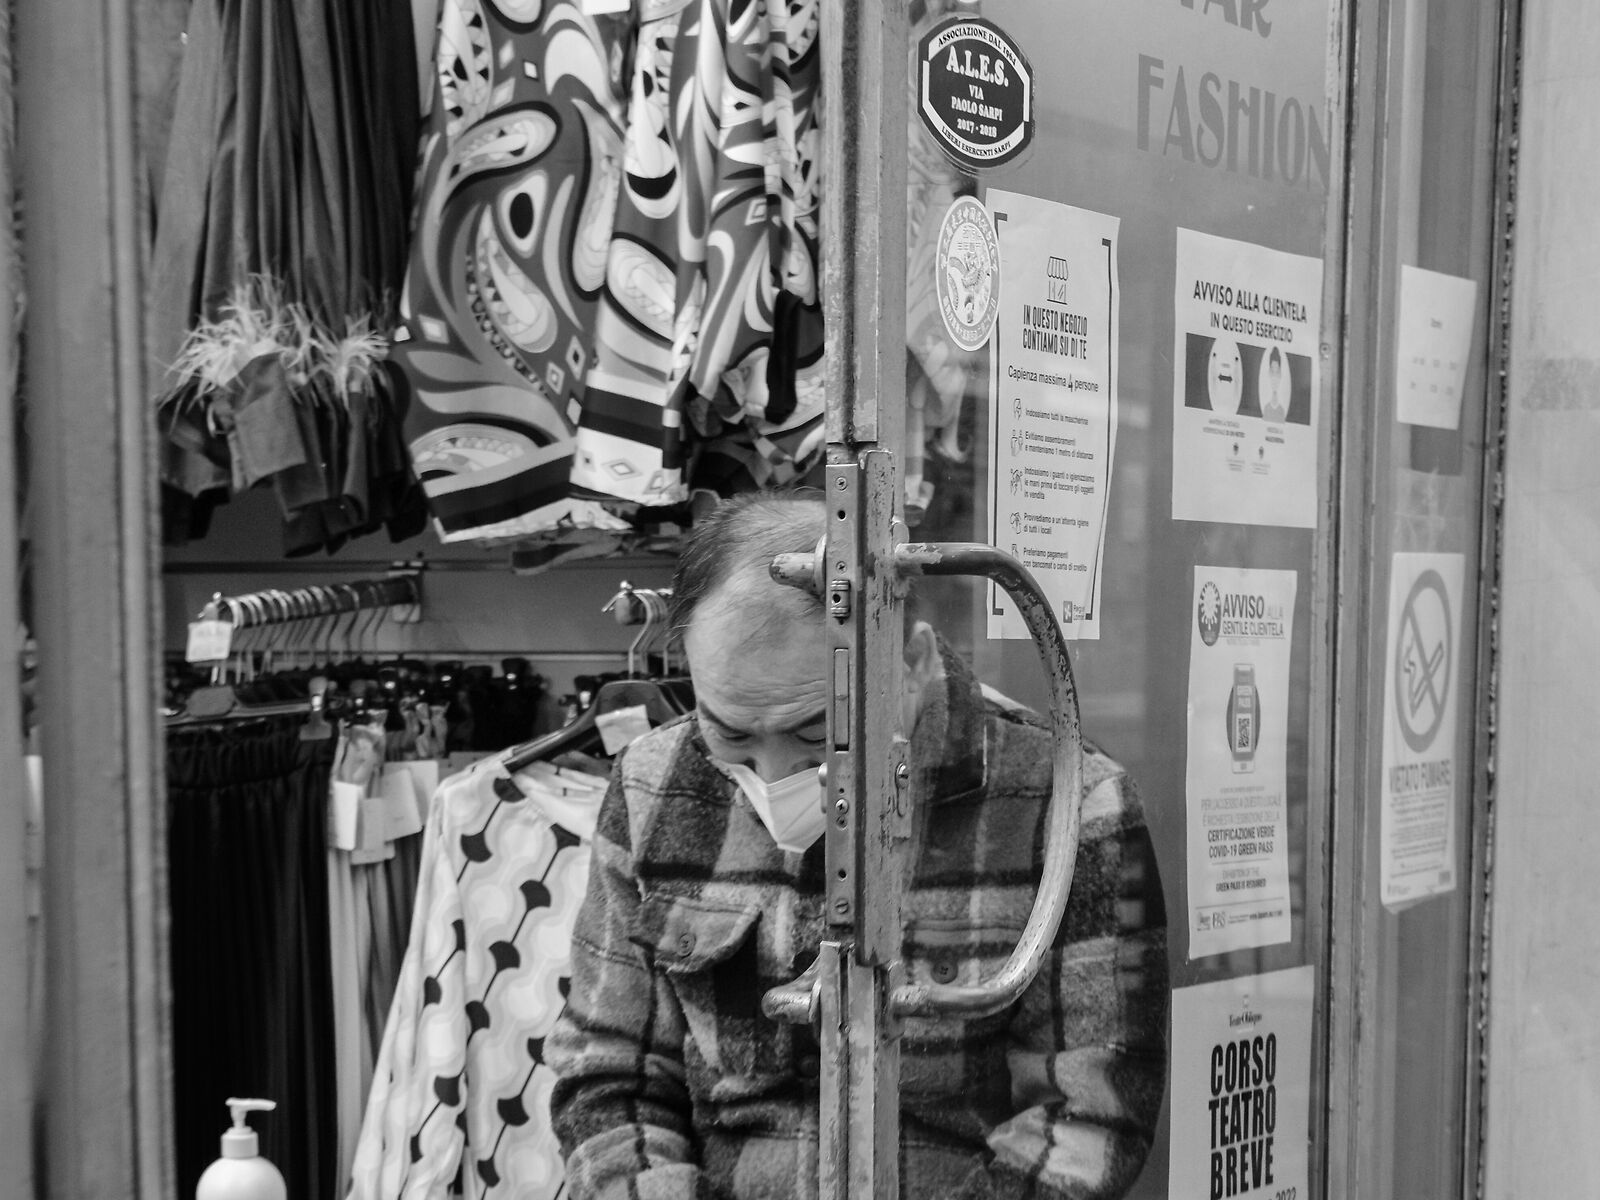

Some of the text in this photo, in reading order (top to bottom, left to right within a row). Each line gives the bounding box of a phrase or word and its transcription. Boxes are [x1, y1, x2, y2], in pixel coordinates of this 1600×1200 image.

[938, 27, 988, 48] ASSOCIAZIONE
[988, 33, 1003, 50] DAL
[946, 44, 1009, 88] A.L.E.S.
[968, 84, 984, 100] VIA
[951, 96, 1003, 122] PAOLO SARPI
[957, 118, 975, 134] 2017
[979, 124, 998, 138] 2018
[1137, 53, 1331, 196] FASHION
[941, 125, 1012, 157] LIBERI ESERCENTI SARPI
[1193, 280, 1307, 324] AVVISO ALLA CLIENTELA
[1023, 304, 1031, 326] IN
[1033, 306, 1059, 332] QUESTO
[1060, 311, 1088, 337] NEGOZIO
[1210, 311, 1293, 343] IN QUESTO ESERCIZIO
[1023, 327, 1087, 360] CONTIAMO SU DI TE
[1008, 365, 1038, 382] Capienza
[1038, 372, 1067, 387] massima
[1074, 379, 1099, 393] persone
[1222, 593, 1265, 620] AVVISO
[1222, 621, 1285, 637] GENTILE CLIENTELA
[1207, 825, 1275, 843] CERTIFICAZIONE VERDE
[1209, 841, 1273, 859] COVID-19 GREEN PASS
[1210, 1032, 1277, 1097] CORSO
[1208, 1084, 1277, 1150] TEATRO
